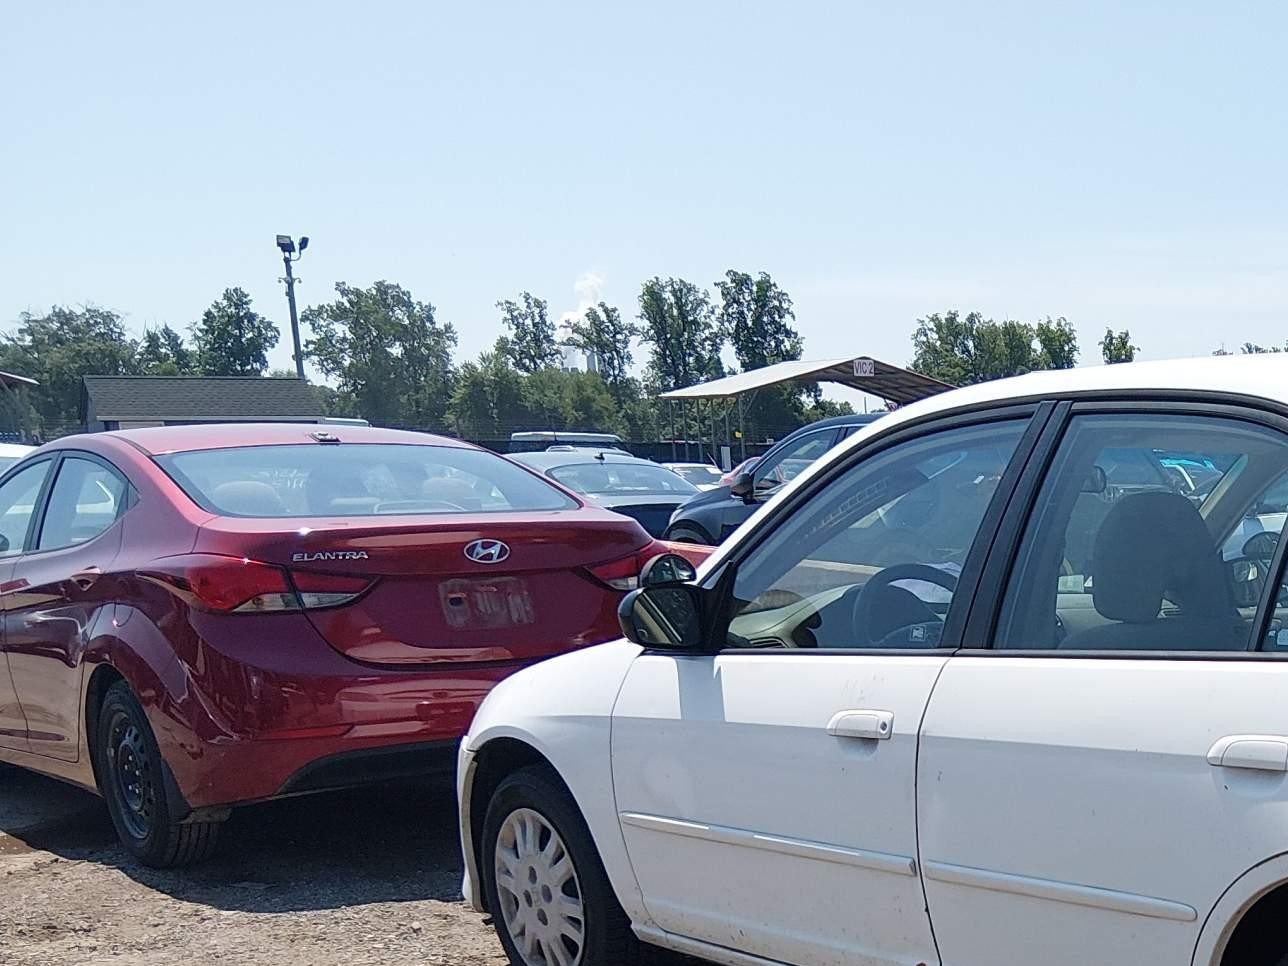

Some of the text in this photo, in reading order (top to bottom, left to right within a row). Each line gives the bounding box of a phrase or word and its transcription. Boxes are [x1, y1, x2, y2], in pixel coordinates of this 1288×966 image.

[854, 361, 874, 375] VIC 2
[292, 551, 369, 562] ELANTRA
